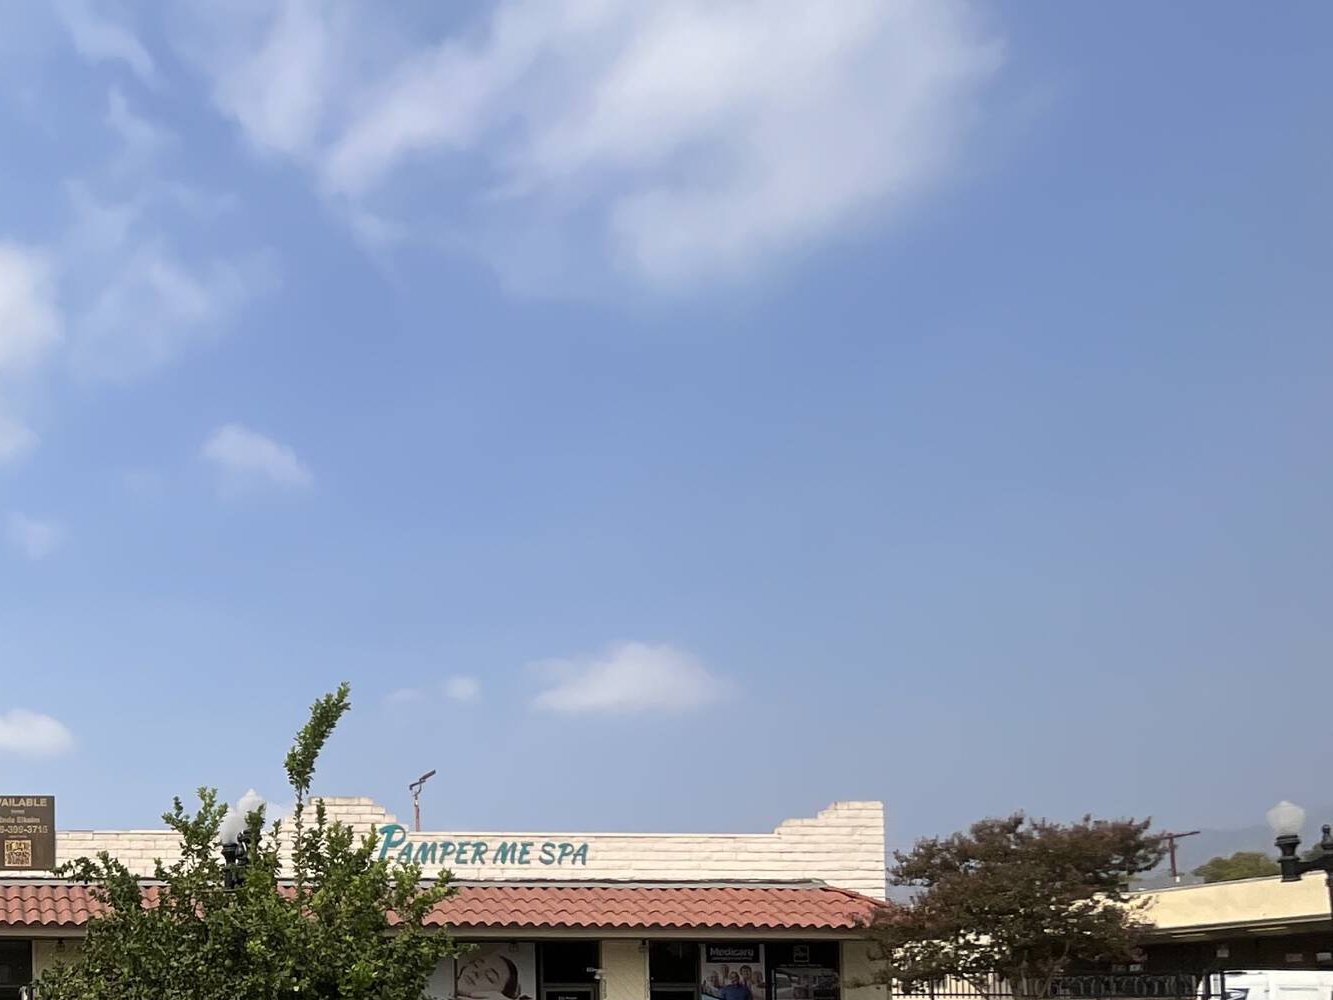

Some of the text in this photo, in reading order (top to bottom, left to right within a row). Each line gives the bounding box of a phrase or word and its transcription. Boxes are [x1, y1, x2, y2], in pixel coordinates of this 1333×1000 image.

[378, 824, 589, 865] PAMPER ME SPA
